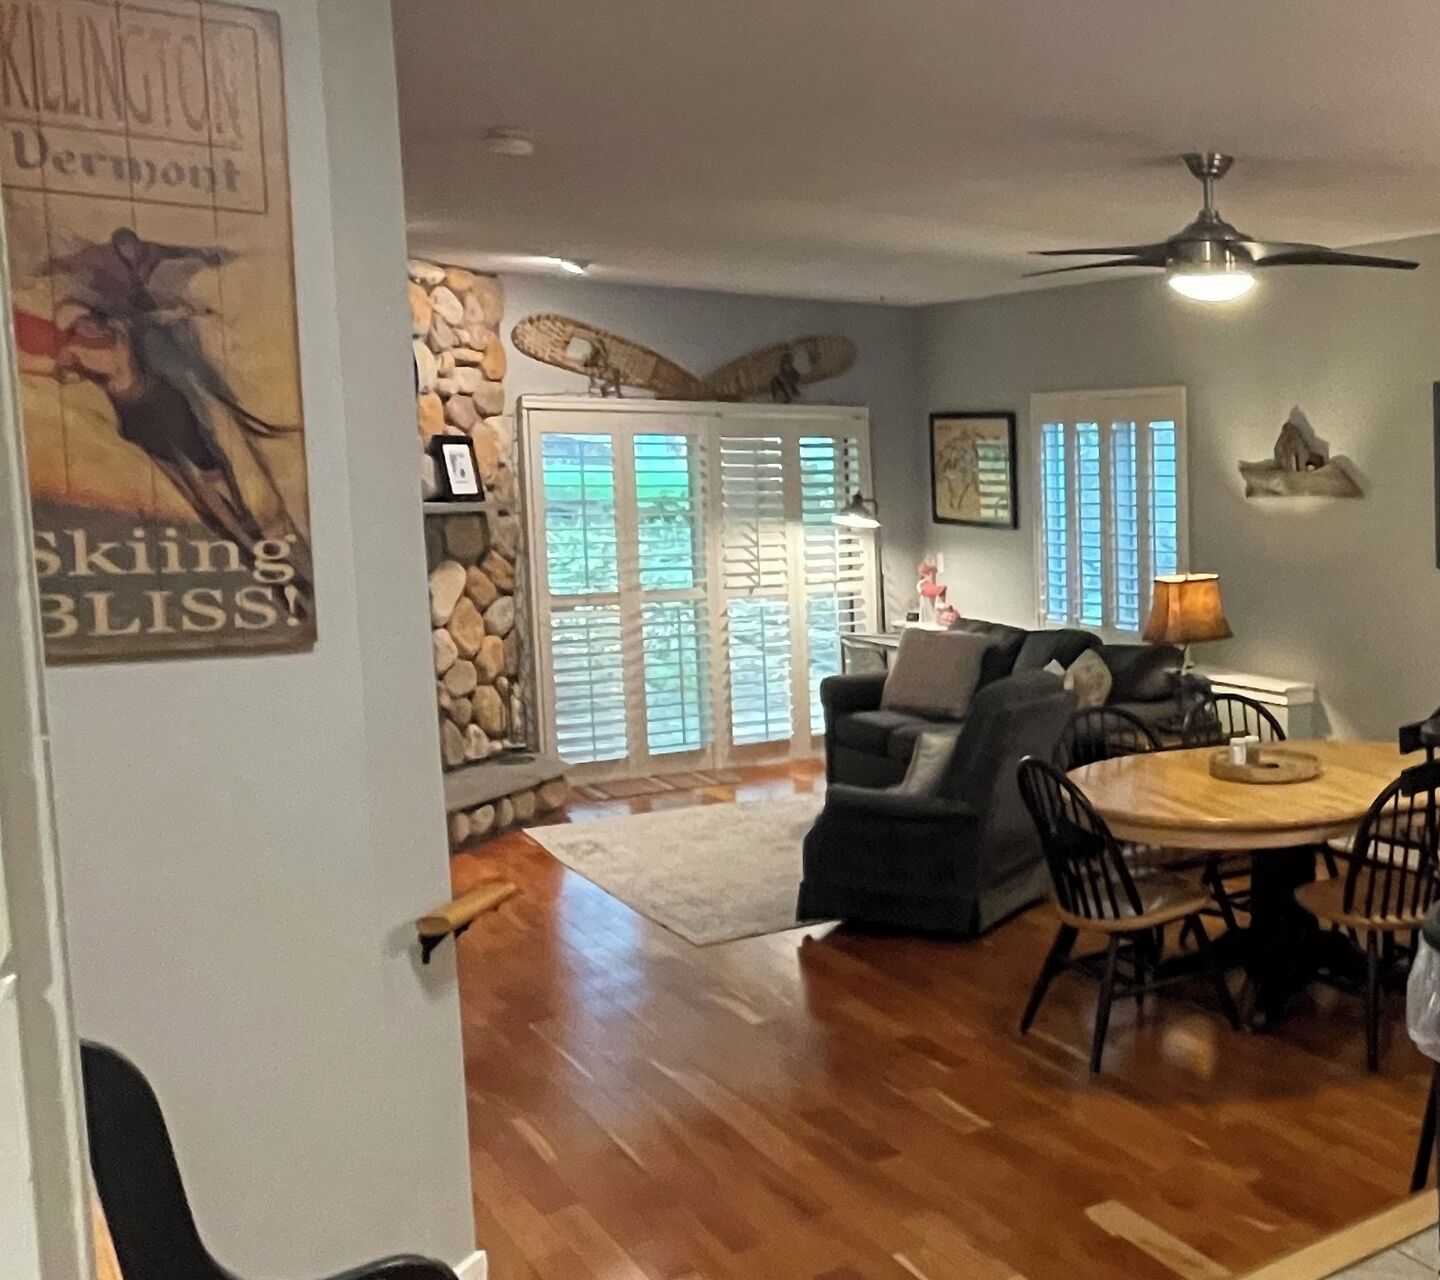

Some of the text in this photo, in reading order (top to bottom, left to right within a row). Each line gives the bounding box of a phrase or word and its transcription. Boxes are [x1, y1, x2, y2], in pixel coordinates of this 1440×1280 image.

[13, 129, 240, 193] Vermont
[35, 527, 297, 583] Skiing
[42, 584, 299, 638] BLISS!
